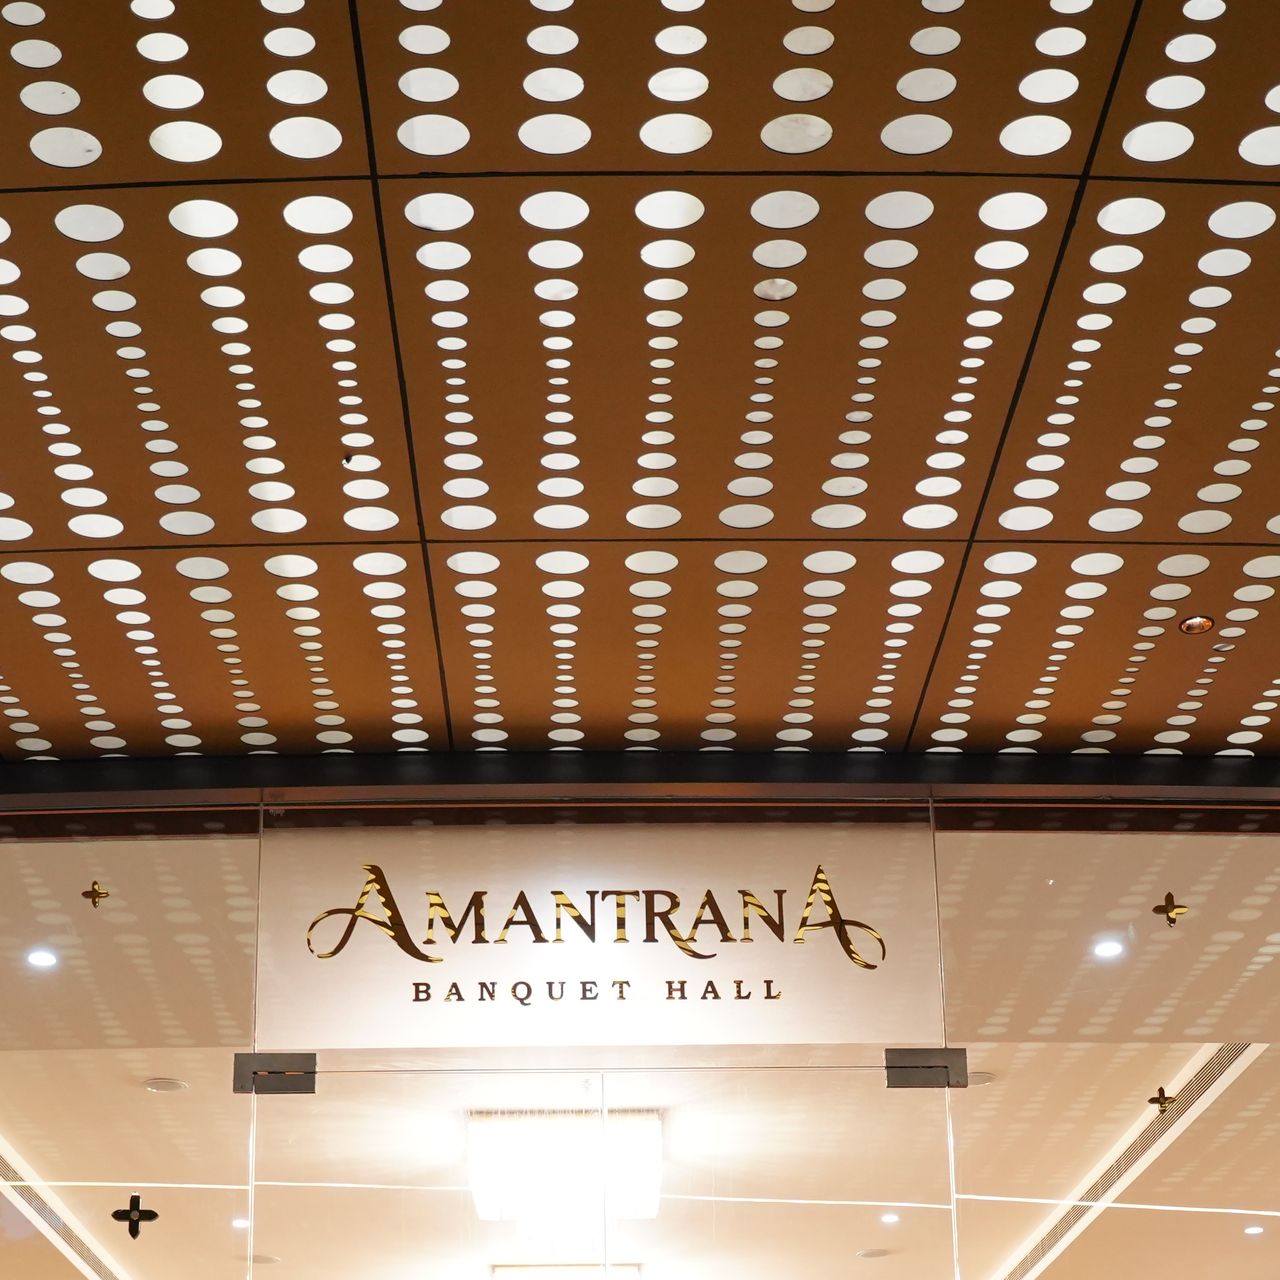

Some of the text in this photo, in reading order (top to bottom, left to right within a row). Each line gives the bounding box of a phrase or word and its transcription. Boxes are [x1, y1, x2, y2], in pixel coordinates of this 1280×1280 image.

[307, 864, 887, 970] AMANTRANA
[412, 979, 783, 1007] BANQUET HALL
